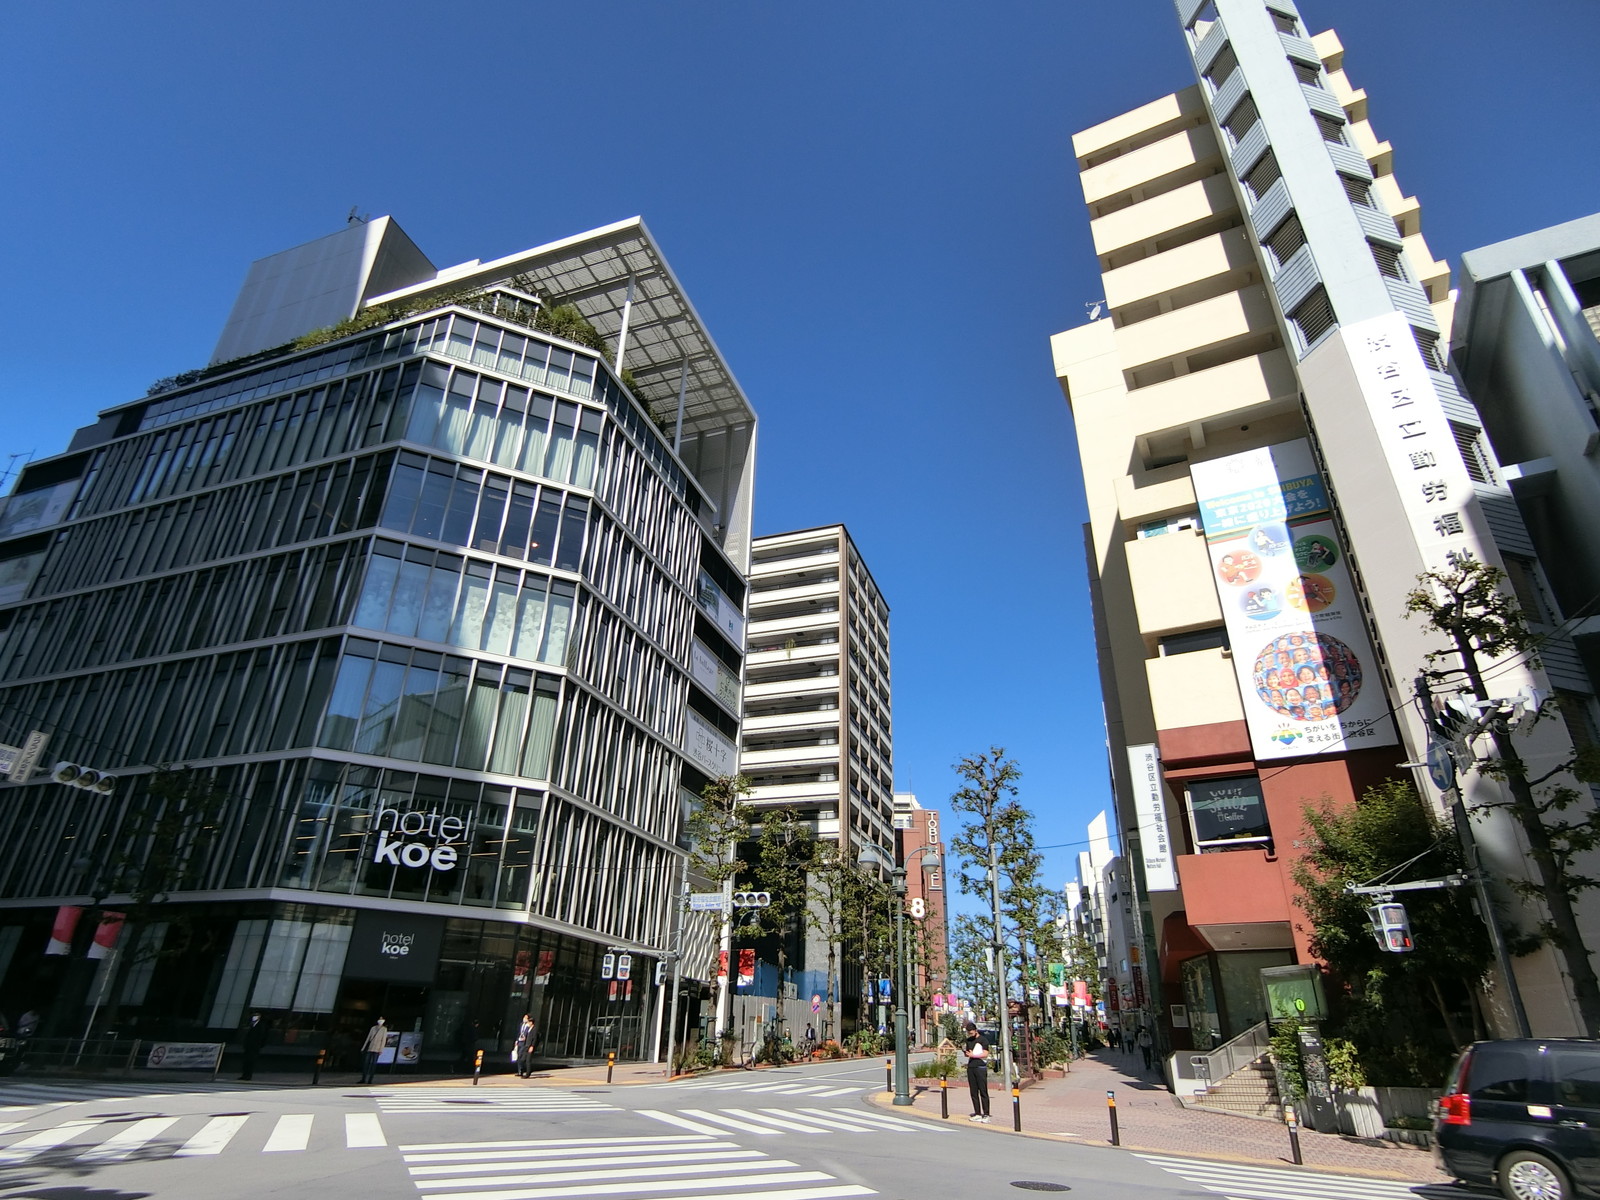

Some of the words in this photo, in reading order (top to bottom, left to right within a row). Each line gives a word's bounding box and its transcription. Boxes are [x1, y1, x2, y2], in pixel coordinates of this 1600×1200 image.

[375, 798, 473, 841] hotel
[927, 811, 938, 845] TOBU
[910, 897, 925, 918] 8
[381, 931, 415, 945] hotel
